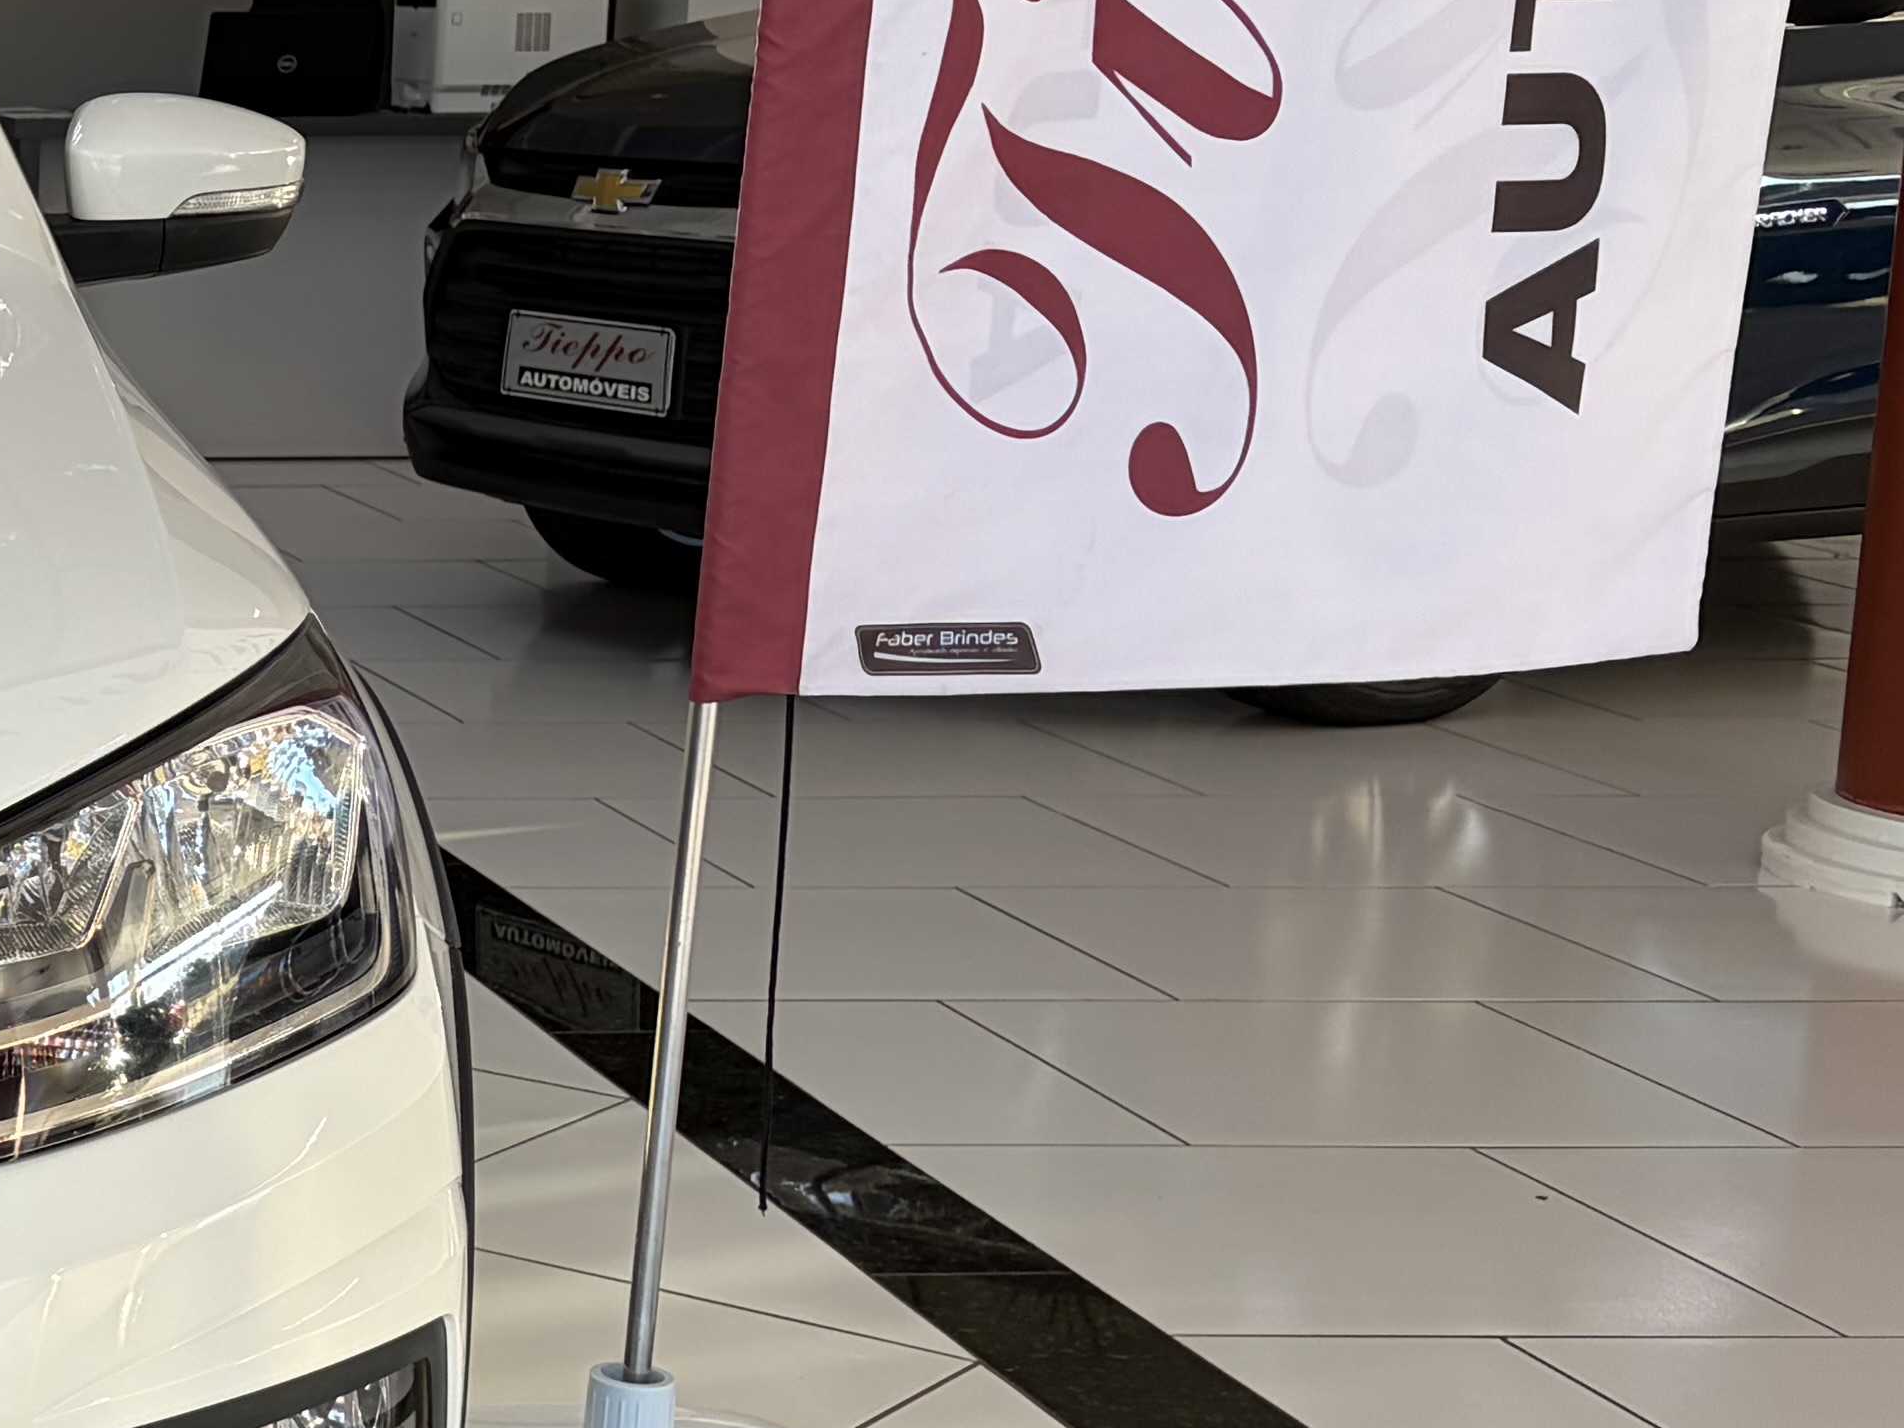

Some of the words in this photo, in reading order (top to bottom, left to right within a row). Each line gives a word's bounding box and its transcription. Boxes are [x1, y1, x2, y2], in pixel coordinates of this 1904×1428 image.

[521, 323, 656, 372] Tieppo
[519, 371, 651, 402] AUTOMÓVEIS
[875, 630, 934, 647] Faber
[940, 629, 1019, 645] Brindes
